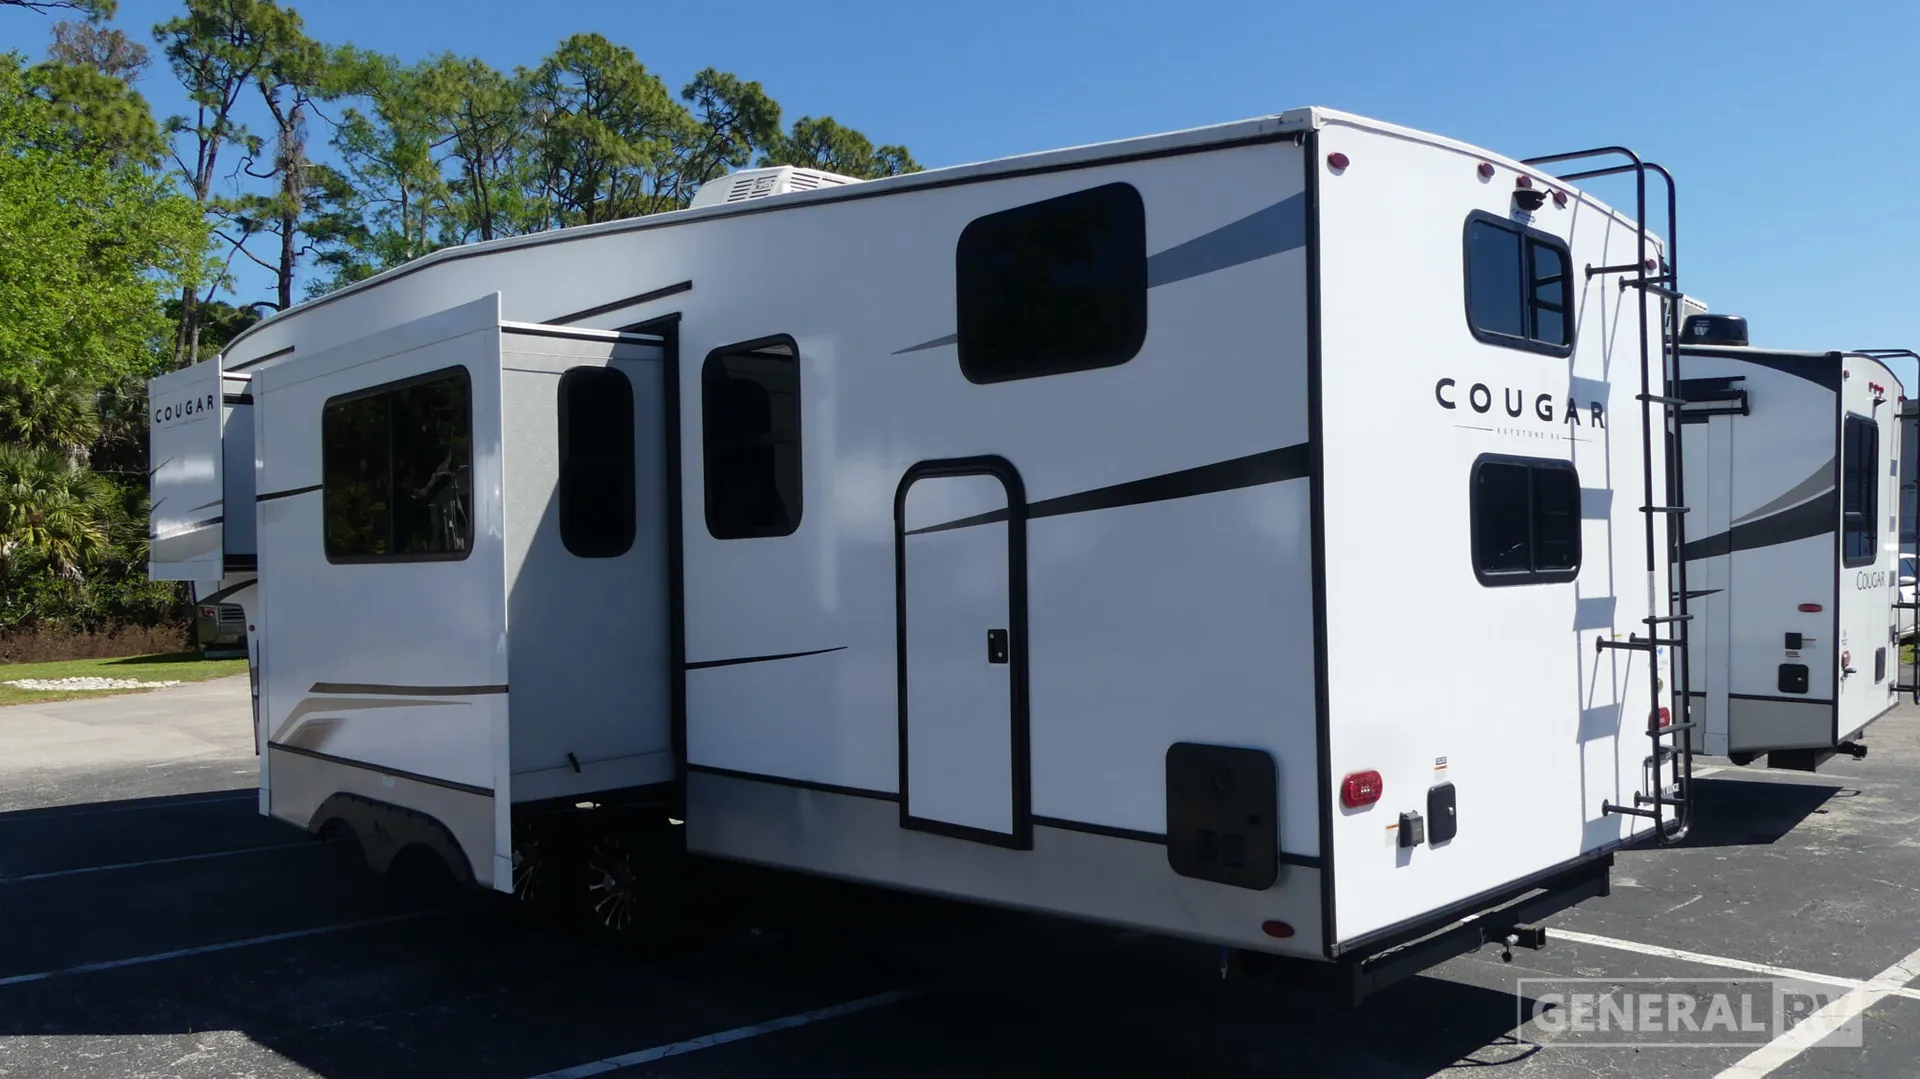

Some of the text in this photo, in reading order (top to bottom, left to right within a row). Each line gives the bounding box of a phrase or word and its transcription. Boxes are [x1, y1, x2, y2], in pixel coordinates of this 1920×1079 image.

[155, 394, 214, 424] COUGAR
[1435, 377, 1606, 429] COUGAR
[1856, 570, 1885, 591] COUGAR
